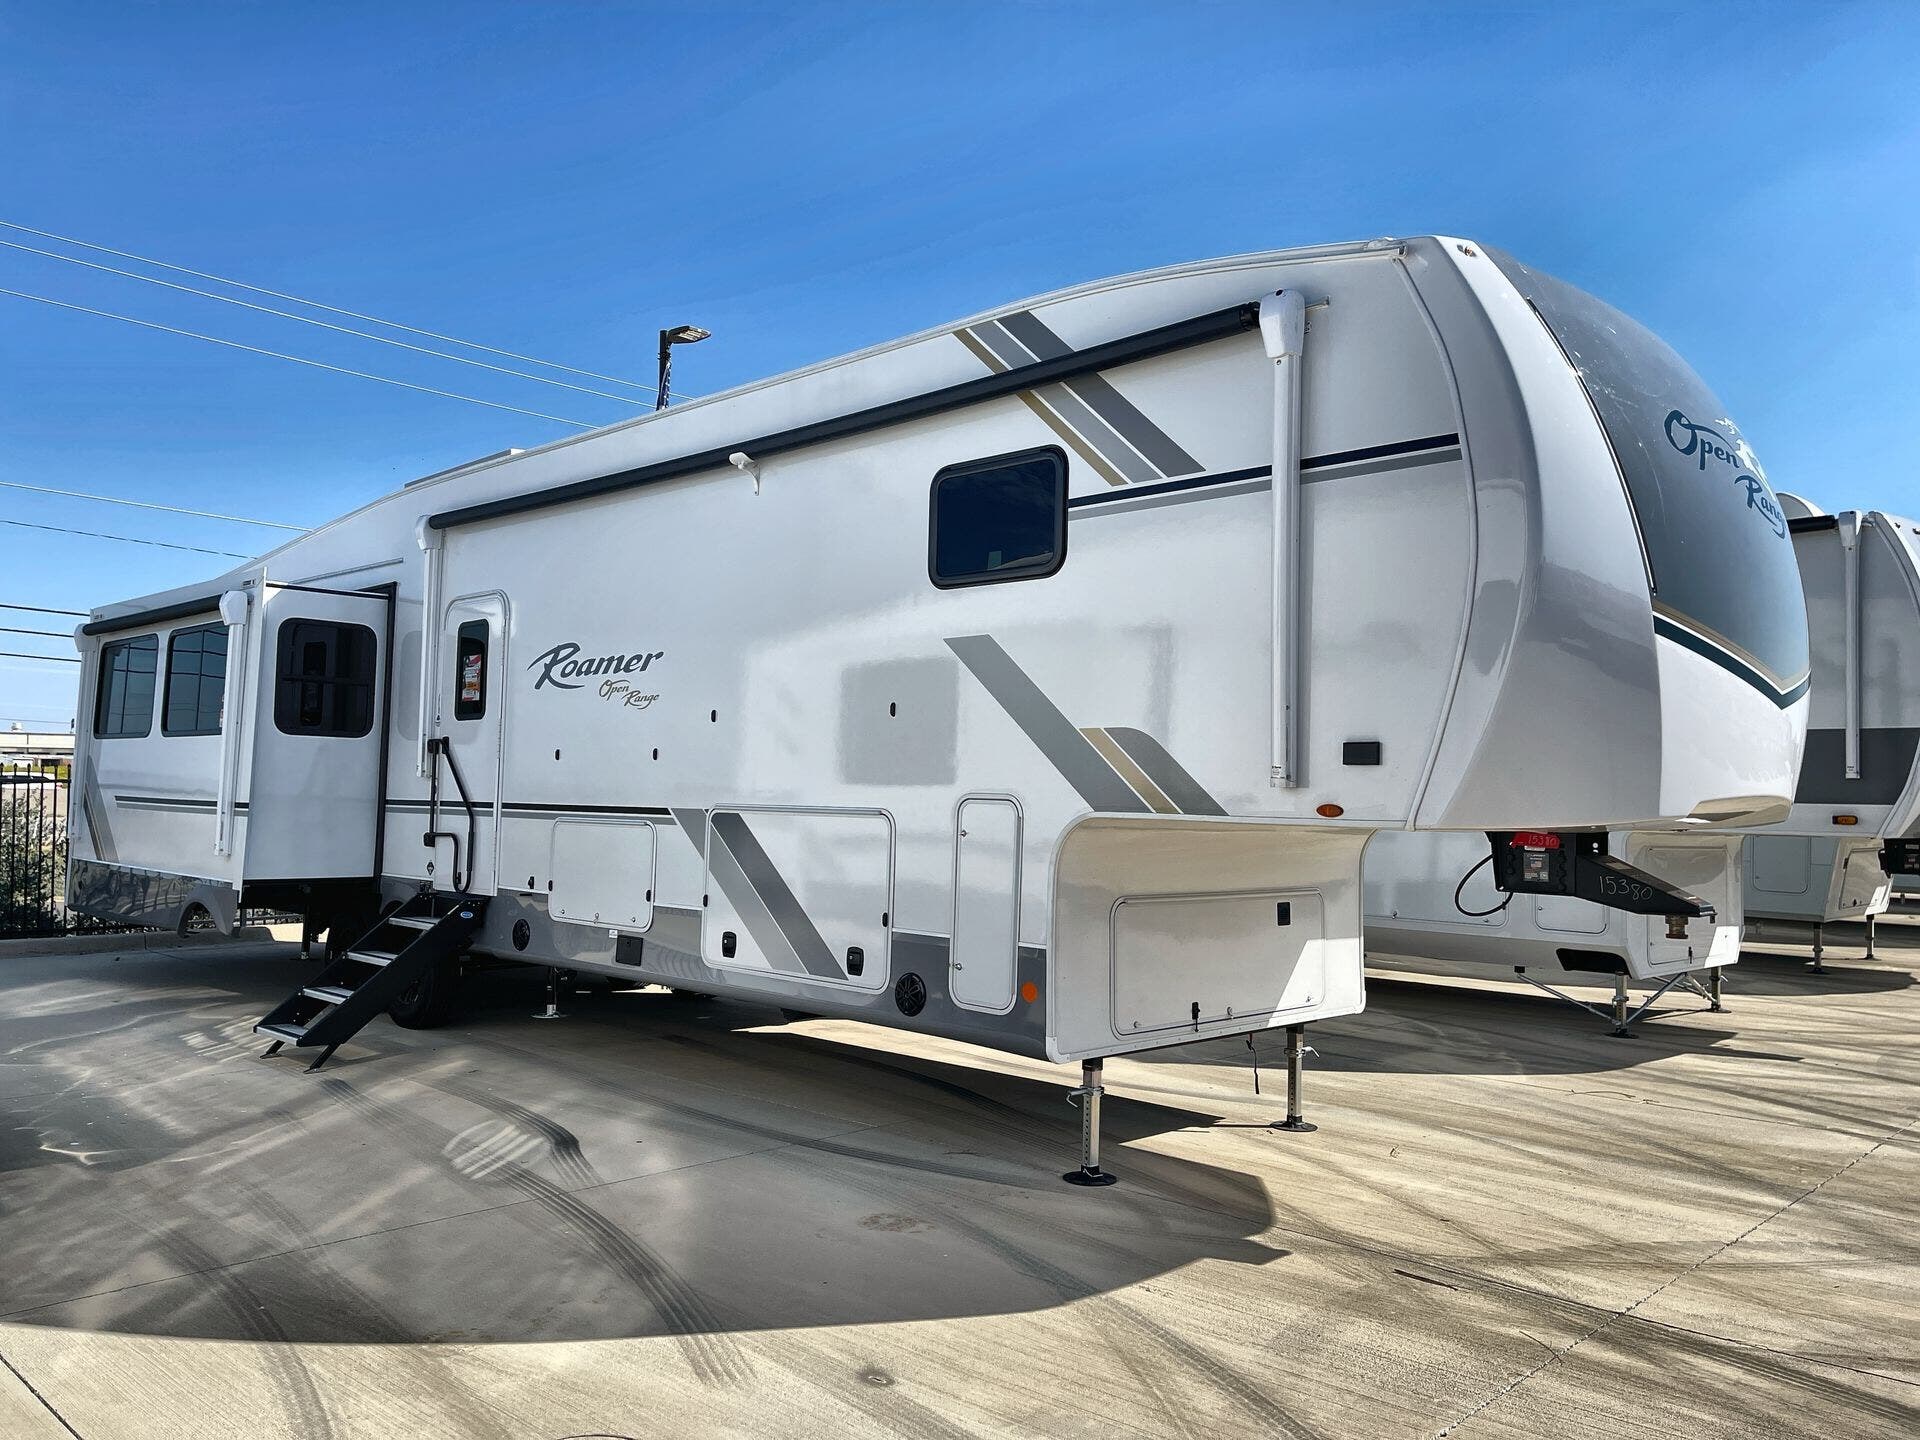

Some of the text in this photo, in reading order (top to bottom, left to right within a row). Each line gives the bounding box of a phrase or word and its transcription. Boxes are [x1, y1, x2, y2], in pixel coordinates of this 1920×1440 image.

[1663, 409, 1740, 471] Open
[1734, 474, 1786, 540] Rang
[527, 642, 665, 690] Roamer
[598, 679, 631, 701] Open
[621, 690, 660, 710] Range
[1599, 875, 1654, 901] 15380
